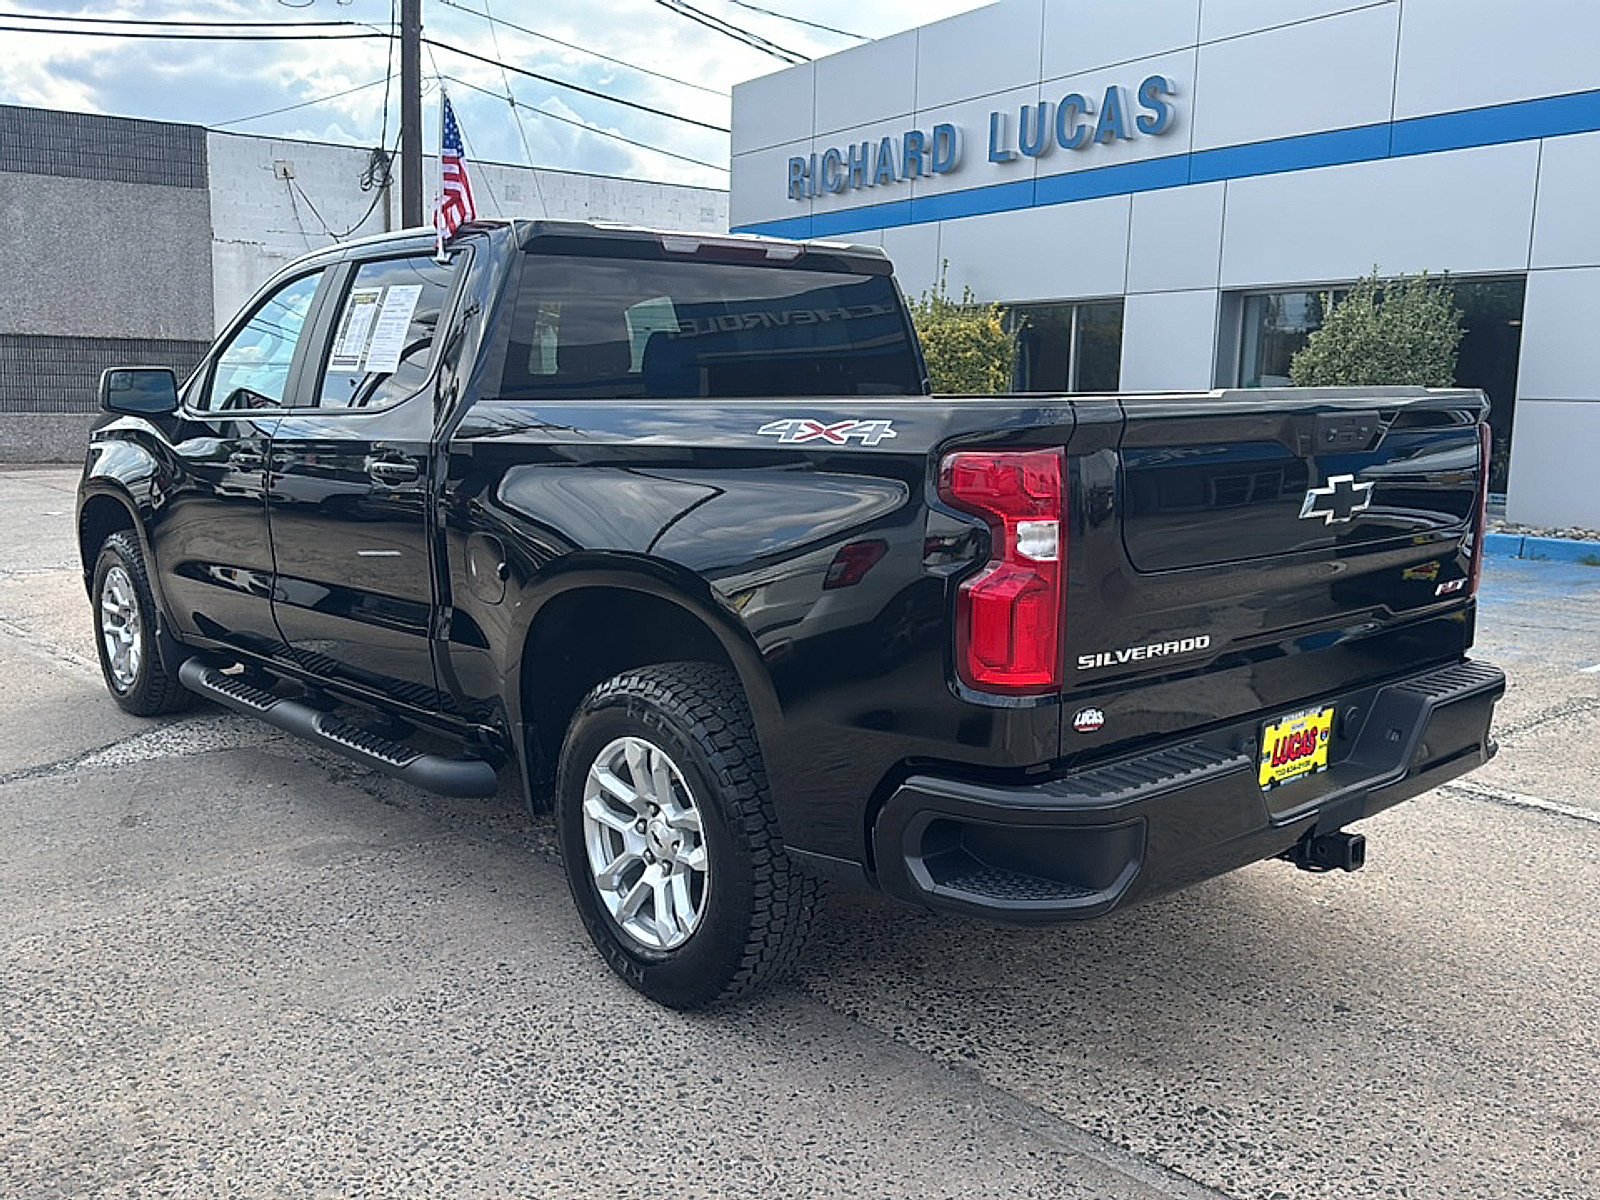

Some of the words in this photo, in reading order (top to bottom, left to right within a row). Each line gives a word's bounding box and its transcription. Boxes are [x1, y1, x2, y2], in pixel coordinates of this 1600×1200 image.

[788, 122, 963, 200] RICHARD
[988, 74, 1177, 163] LUCAS
[1077, 635, 1211, 670] SILVERADO
[1073, 709, 1106, 727] LUCAS
[1271, 726, 1319, 768] LUCAS
